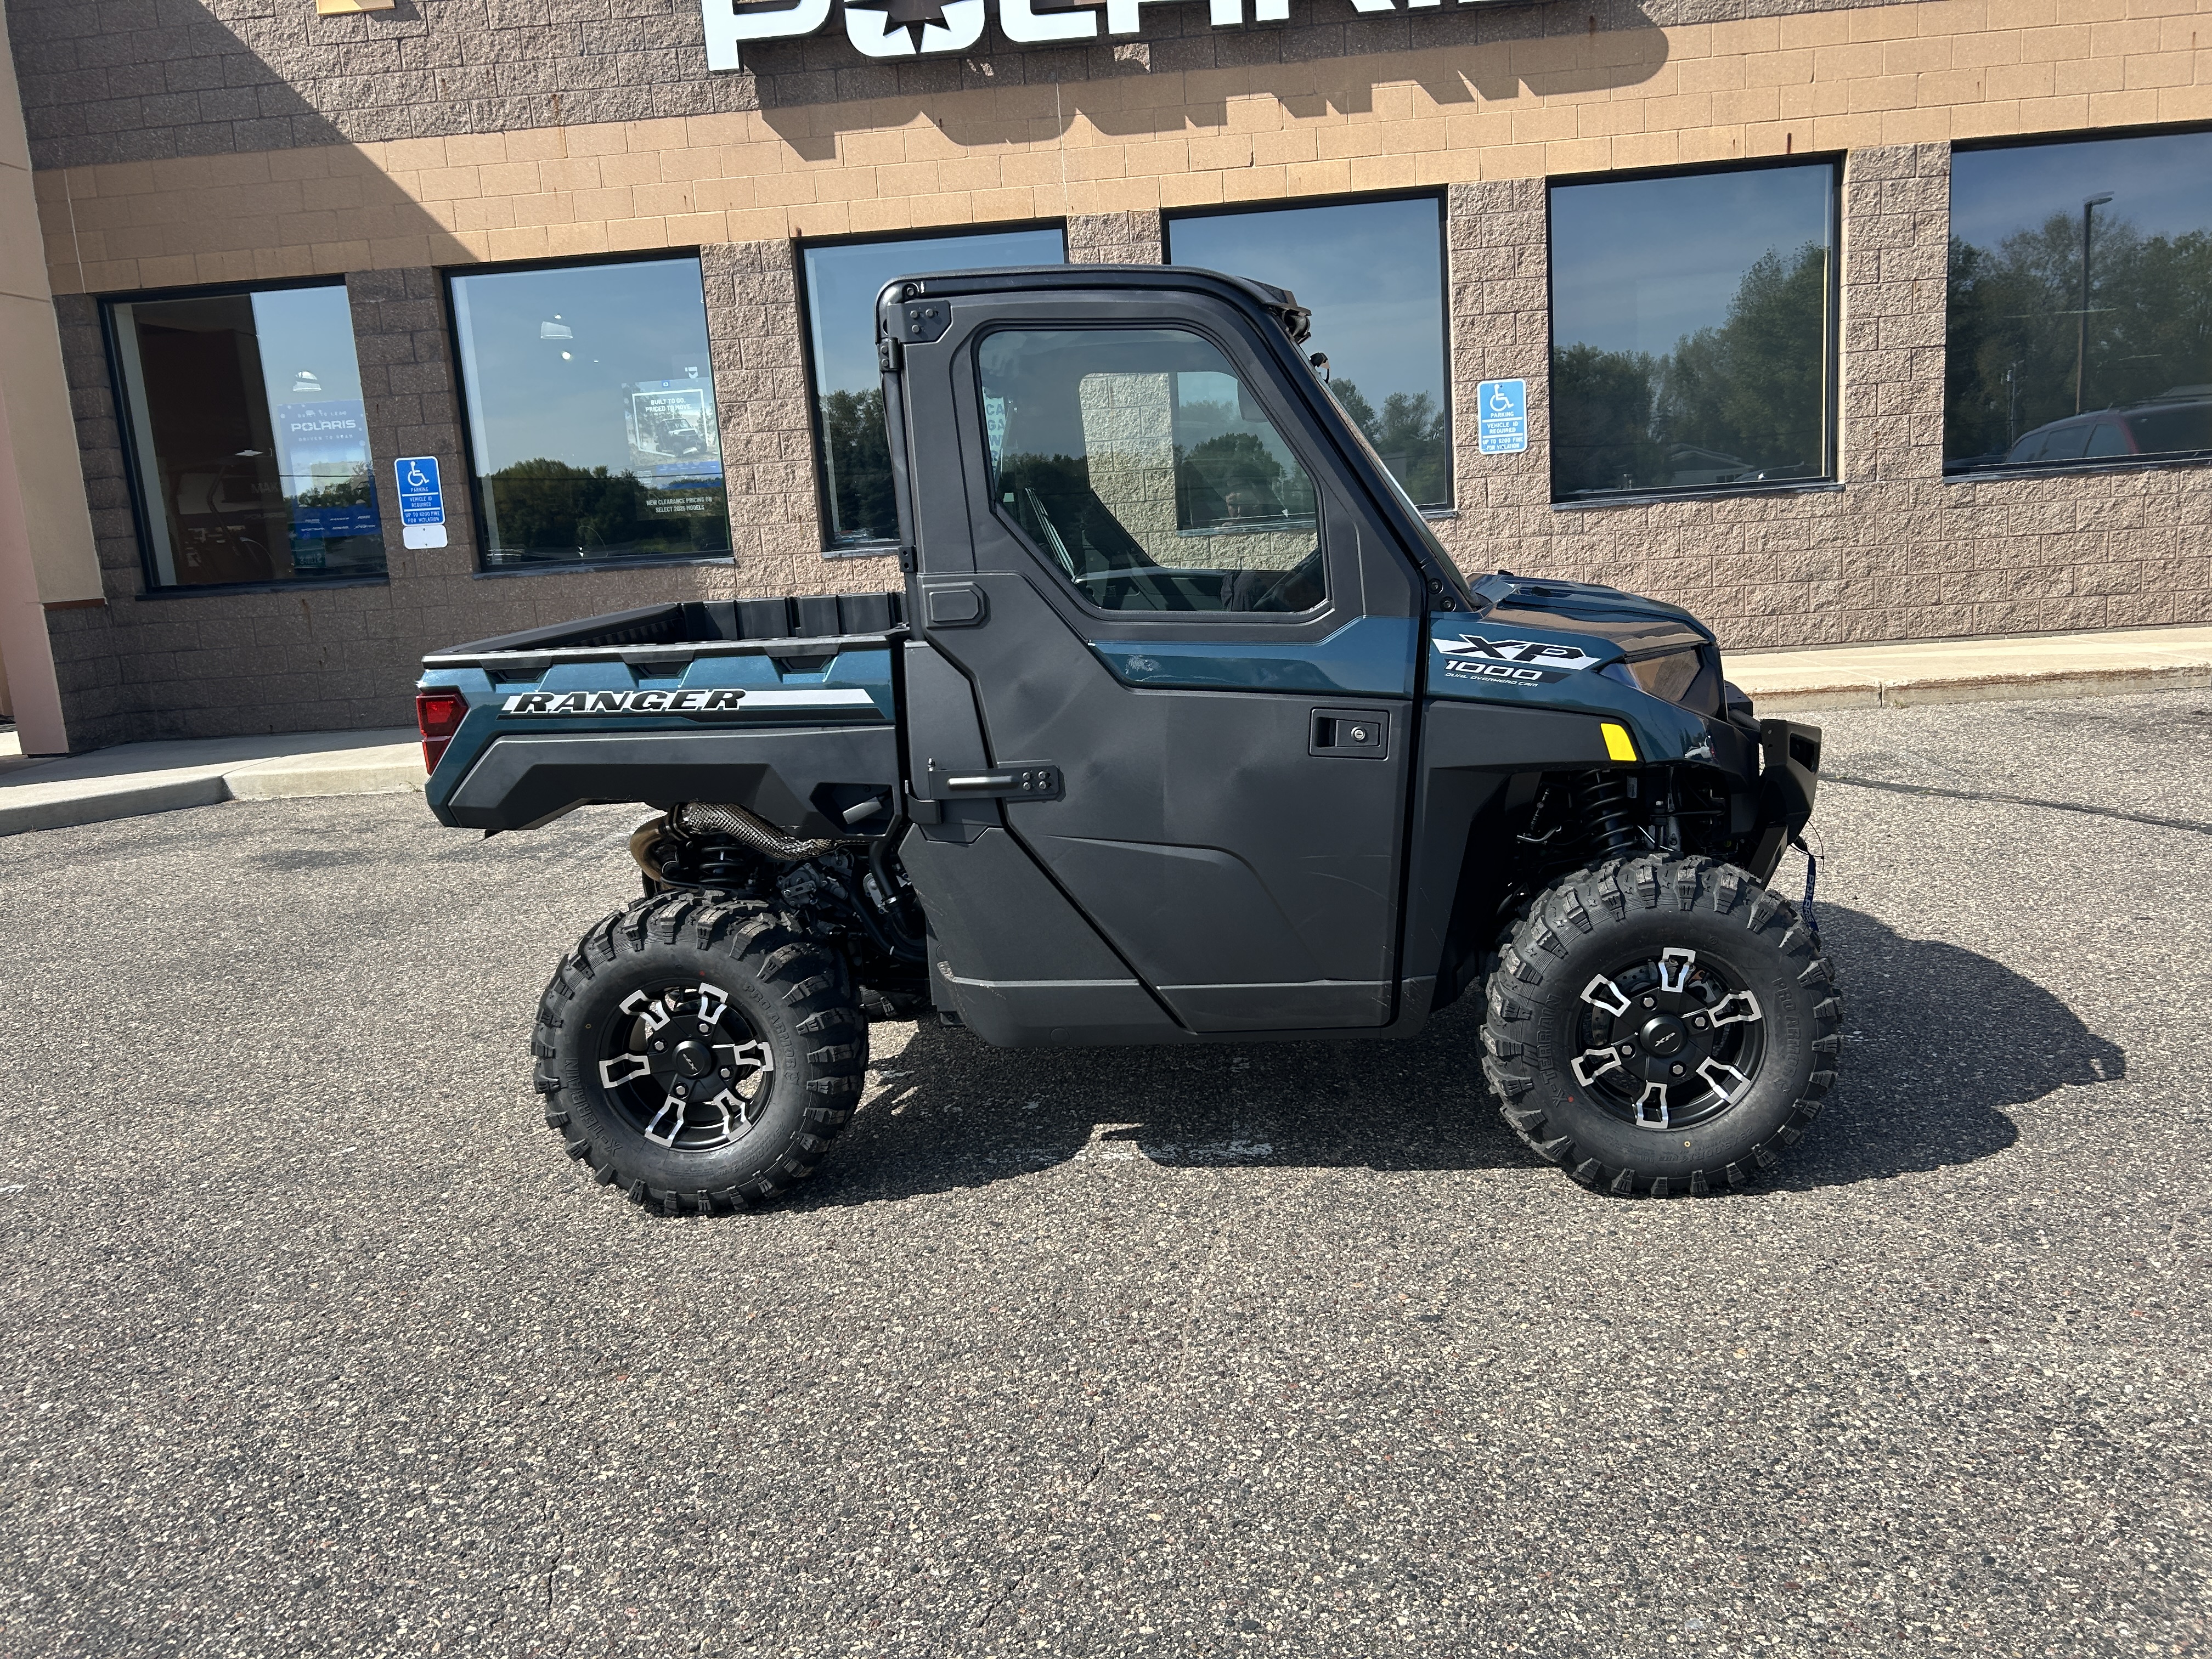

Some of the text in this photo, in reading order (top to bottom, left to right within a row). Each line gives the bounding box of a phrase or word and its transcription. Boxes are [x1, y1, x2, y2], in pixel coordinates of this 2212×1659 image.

[291, 419, 356, 432] POLARIS
[1442, 634, 1586, 662] XP
[1444, 660, 1543, 680] 1000
[1470, 675, 1517, 685] OVERHEAD
[511, 689, 746, 713] RANGER
[743, 983, 797, 1068] PRO ARMOR
[1771, 978, 1801, 1077] PRO ARMOR
[1537, 994, 1568, 1107] X-TERRAIN
[565, 1058, 623, 1156] X-TERRAIN
